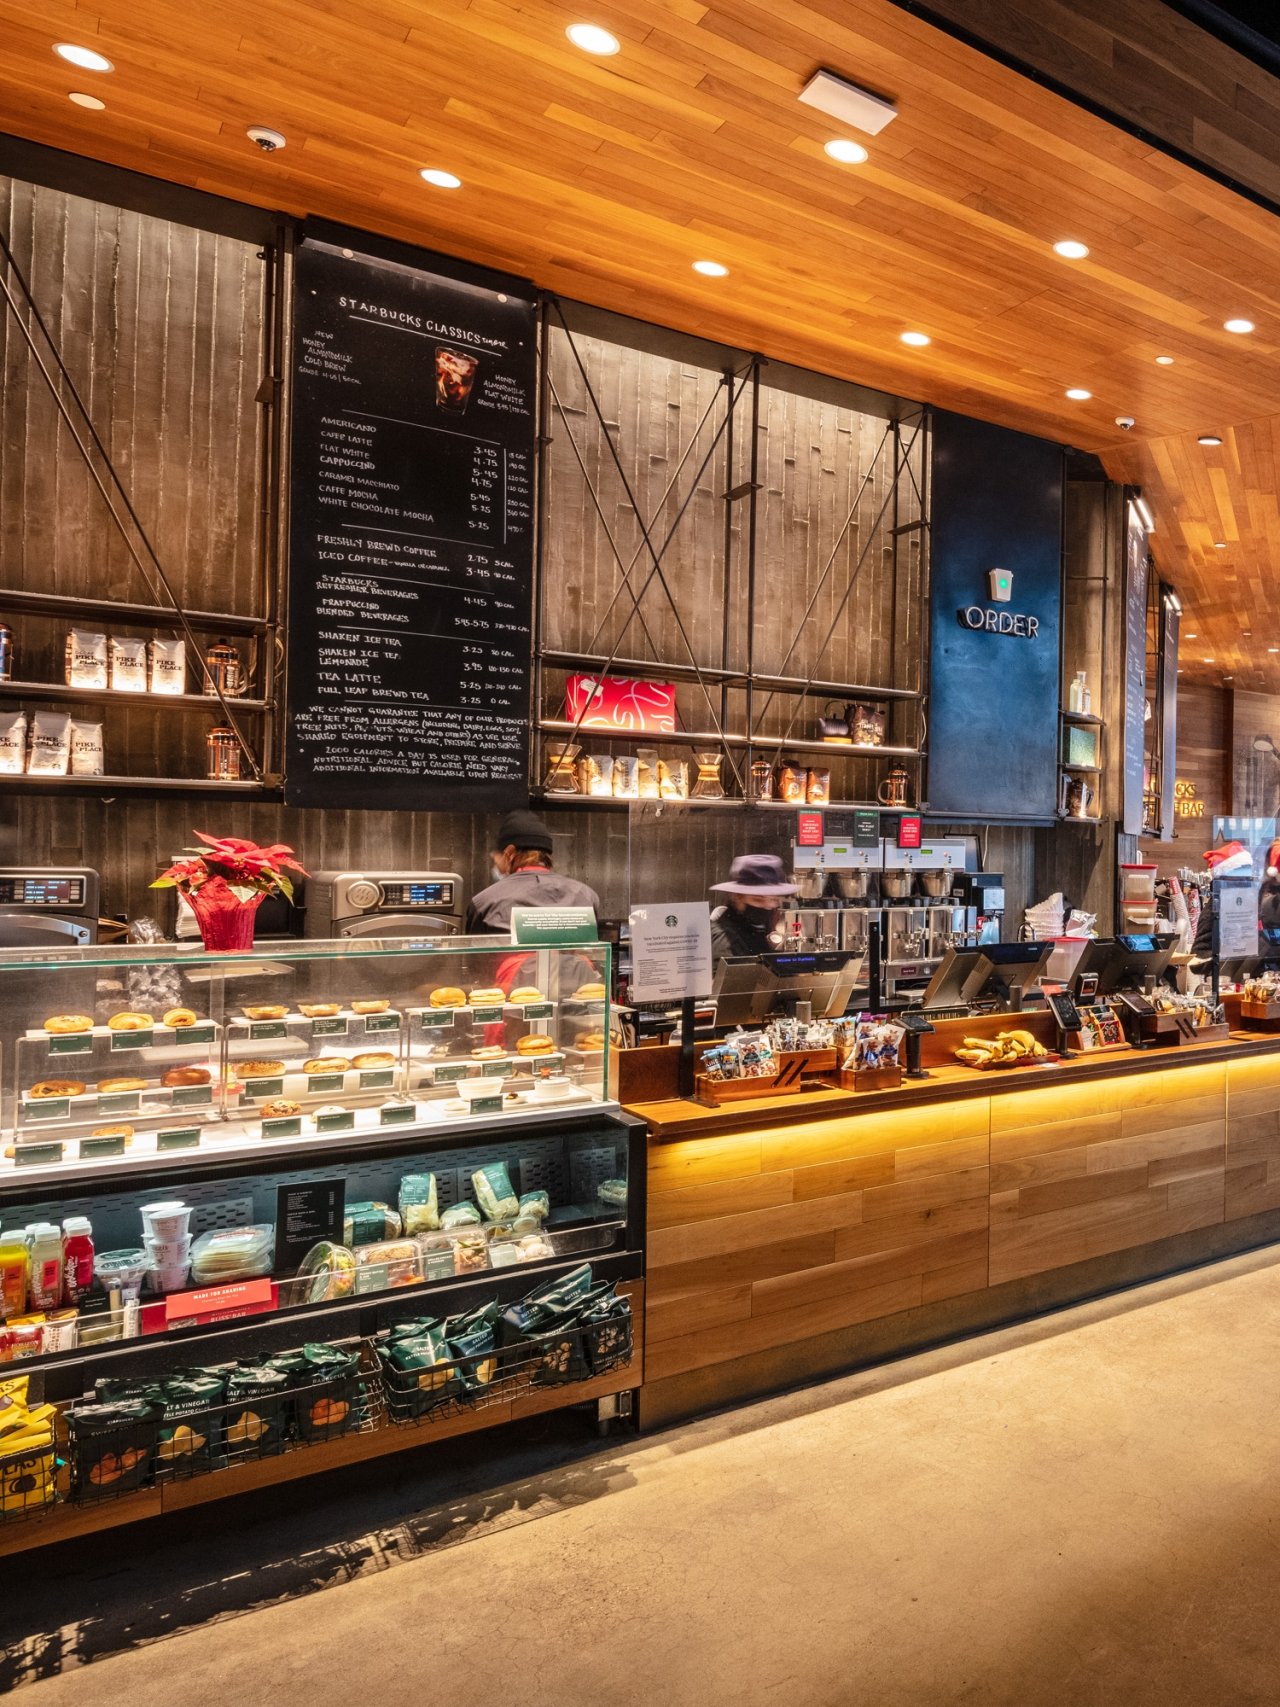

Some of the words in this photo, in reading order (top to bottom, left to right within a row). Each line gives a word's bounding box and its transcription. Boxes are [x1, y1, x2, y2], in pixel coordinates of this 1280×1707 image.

[339, 296, 421, 328] STARBUCKS
[426, 320, 481, 344] CLASSICS
[302, 337, 325, 349] HONEY
[324, 360, 347, 372] BREW
[320, 416, 377, 433] AMERICANO
[348, 435, 373, 447] LATTE
[320, 443, 339, 454] FLAT
[342, 447, 371, 460] WHITE
[319, 455, 376, 470] CAPPUCCINO
[318, 484, 346, 495] CAFFE
[348, 489, 379, 501] MOCHA
[318, 496, 348, 508] WHITE
[350, 501, 400, 517] CHOCOLATE
[402, 510, 435, 523] MOCHA
[316, 534, 363, 548] FRESHLY
[366, 540, 401, 553] BREWD
[403, 545, 437, 558] COFFEE
[318, 551, 345, 561] ICED
[321, 574, 379, 589] STARBUCKS
[315, 581, 370, 595] REFRESHER
[370, 586, 420, 600] BEVERAGES
[321, 598, 380, 610] FRAPPUCCINO
[315, 606, 355, 617] BLENDED
[360, 610, 410, 623] BEVERAGES
[965, 606, 1039, 638] ORDER
[318, 630, 361, 643] SHAKEN
[363, 635, 381, 644] ICE
[382, 637, 402, 647] TEA
[318, 647, 356, 657] SHAKEN
[360, 649, 380, 658] ICE
[319, 657, 370, 668] LEMONADE
[316, 672, 341, 681] TEA
[344, 673, 382, 684] LATTE
[317, 686, 342, 695] FULL
[371, 689, 408, 699] BREWD
[409, 691, 430, 701] TEA
[294, 713, 313, 721] ARE
[317, 714, 341, 722] FREE
[344, 716, 370, 724] FROM
[372, 717, 420, 727] ALLERGENS
[308, 705, 324, 713] WE
[328, 705, 364, 714] CANNOT
[367, 707, 419, 717] GUARANTEE
[421, 710, 443, 719] THAT
[444, 712, 462, 721] ANY
[475, 715, 494, 723] OUR
[295, 723, 322, 731] TREE
[472, 733, 484, 741] AS
[296, 732, 337, 741] SHARED
[341, 732, 394, 742] EQUIPMENT
[398, 735, 409, 743] TO
[479, 741, 497, 749] AND
[325, 746, 350, 754] 2000
[353, 748, 394, 757] CALORIES
[397, 750, 405, 758] A
[407, 751, 425, 760] DAY
[313, 755, 373, 764] NUTRITIONAL
[377, 758, 408, 767] ADVICE
[465, 762, 487, 771] NEED
[423, 768, 465, 778] AVAILABLE
[1182, 802, 1205, 816] BAR
[222, 1286, 247, 1295] SHARING
[564, 1289, 582, 1301] BUTTER
[521, 1305, 539, 1319] BUTTER
